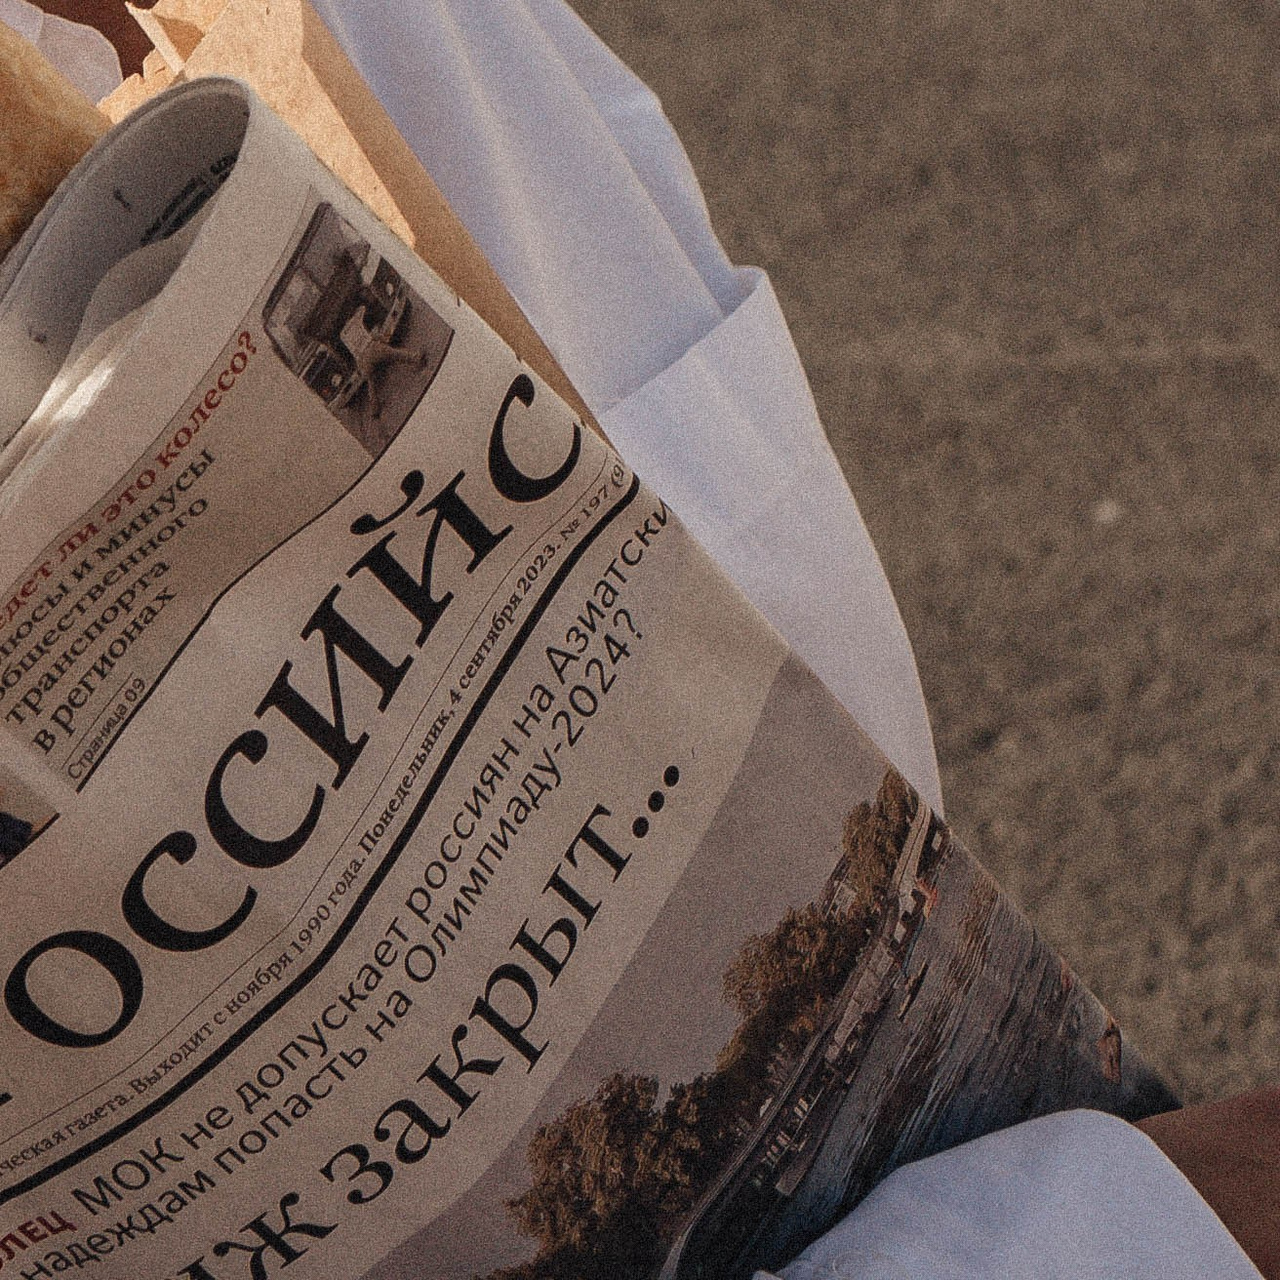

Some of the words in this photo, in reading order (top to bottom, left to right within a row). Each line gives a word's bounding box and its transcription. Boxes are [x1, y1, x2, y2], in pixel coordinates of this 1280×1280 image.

[58, 522, 101, 562] ли
[100, 469, 157, 524] это
[154, 330, 257, 469] колесо?
[71, 559, 94, 582] и
[94, 449, 215, 561] минусы
[5, 561, 171, 725] транспорта
[32, 728, 56, 755] в
[50, 586, 177, 737] регионах
[65, 1094, 135, 1137] газета.
[128, 1022, 213, 1096] Выходит
[213, 1011, 227, 1026] с
[224, 951, 294, 1016] ноября
[289, 904, 331, 955] 1990
[327, 857, 367, 907] года.
[357, 709, 456, 855] Понедельник,
[449, 689, 462, 705] 4
[459, 592, 523, 690] сентября
[516, 543, 562, 595] 2023.
[559, 518, 581, 541] №
[580, 484, 608, 519] 197
[609, 464, 625, 490] (9
[67, 703, 129, 780] Страница
[124, 677, 146, 703] 09
[19, 1170, 216, 1280] надеждам
[213, 1047, 368, 1175] попасть
[364, 990, 413, 1043] на
[404, 608, 643, 984] Олимпиаду-2024?
[70, 1136, 185, 1216] МОК
[179, 1105, 234, 1151] не
[235, 916, 409, 1115] допускает
[404, 737, 520, 925] россиян
[512, 683, 556, 739] на
[176, 1192, 338, 1280] ж
